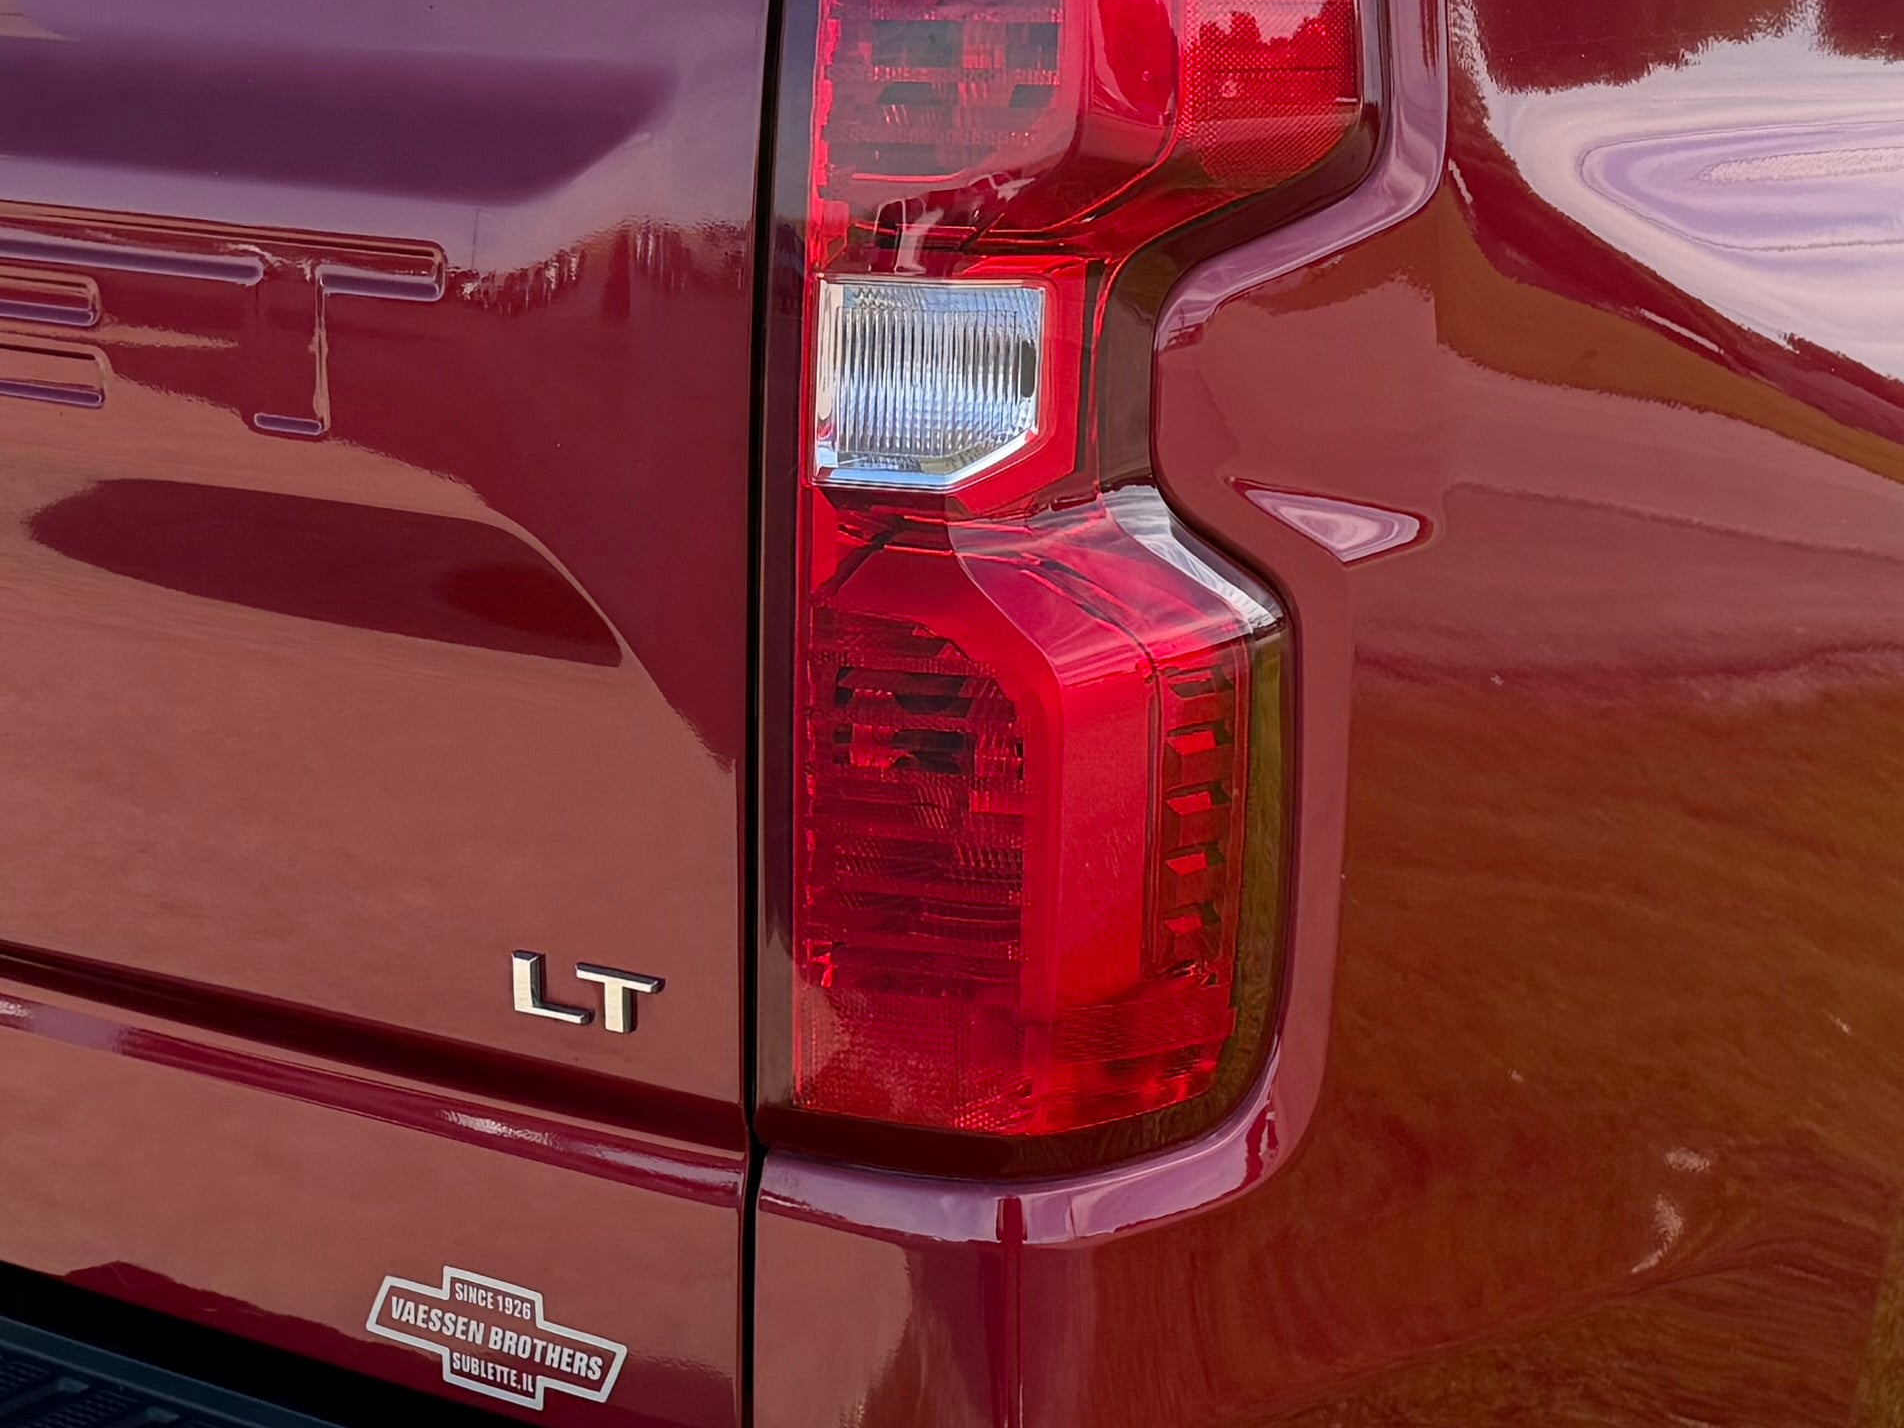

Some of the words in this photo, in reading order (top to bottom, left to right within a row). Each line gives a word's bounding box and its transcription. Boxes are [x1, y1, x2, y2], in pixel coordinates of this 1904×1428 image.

[511, 950, 666, 1033] LT
[391, 1296, 484, 1344] VAESSEN
[488, 1326, 604, 1380] BROTHERS
[455, 1282, 495, 1310] SINCE
[496, 1295, 532, 1321] 1926
